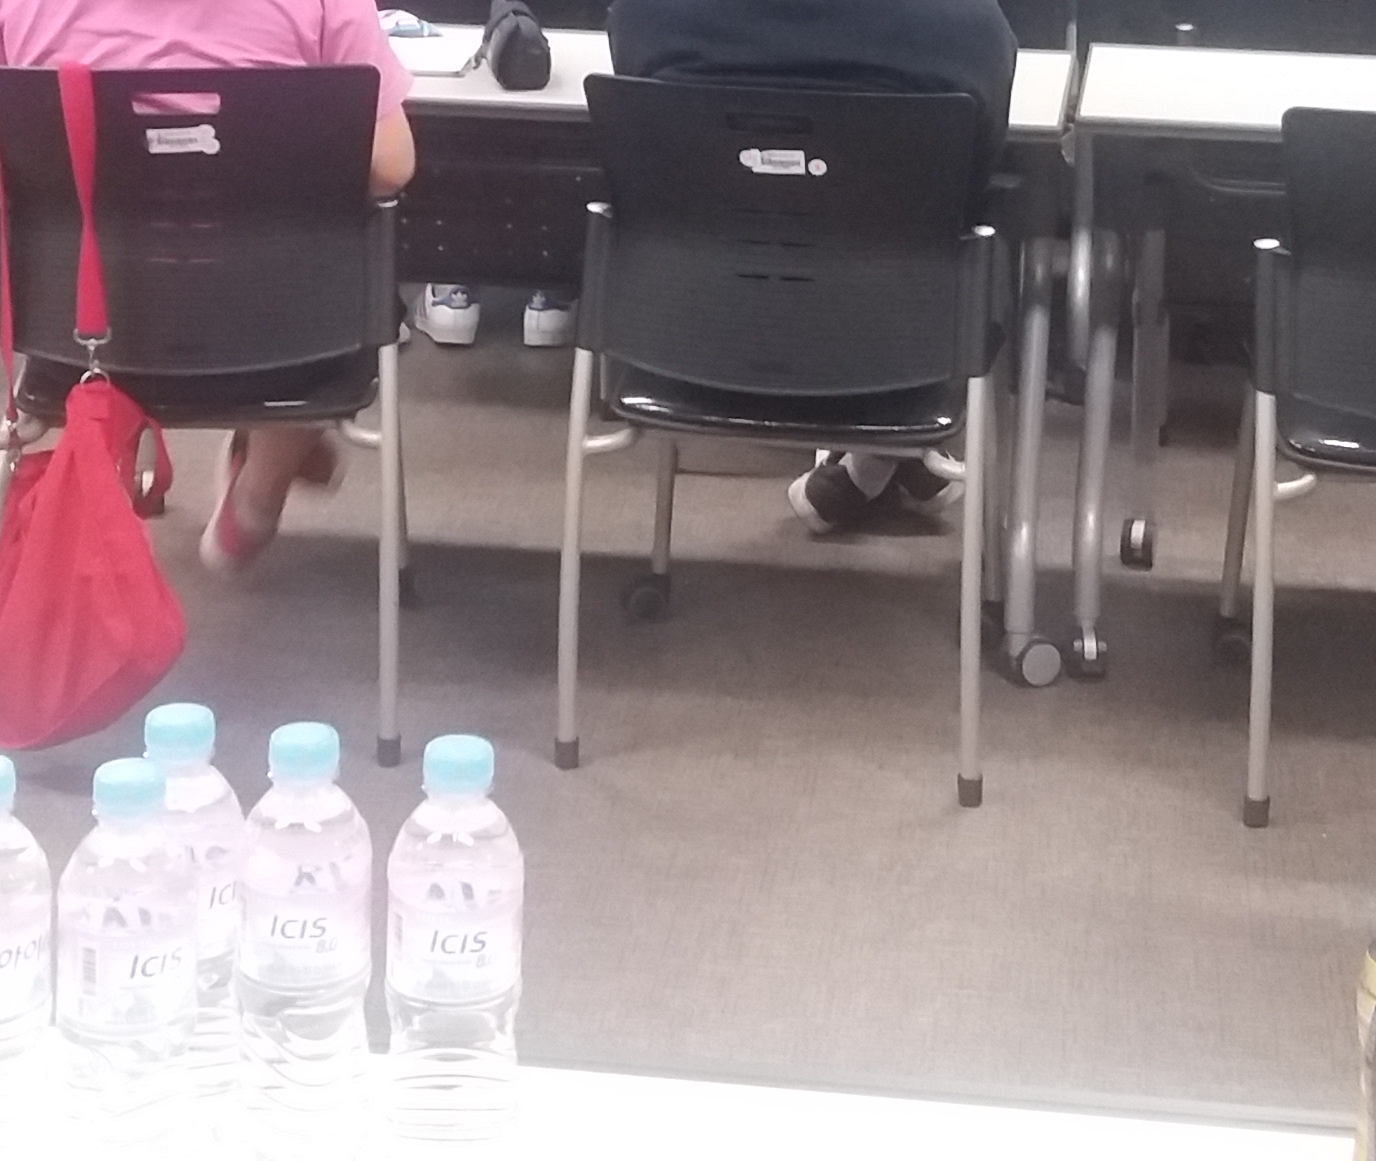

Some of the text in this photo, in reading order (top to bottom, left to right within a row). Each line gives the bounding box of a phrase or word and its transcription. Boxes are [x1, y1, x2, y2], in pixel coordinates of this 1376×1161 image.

[208, 880, 238, 910] ICI
[269, 913, 328, 940] ICIS
[429, 929, 488, 955] ICIS
[128, 946, 183, 980] ICIS
